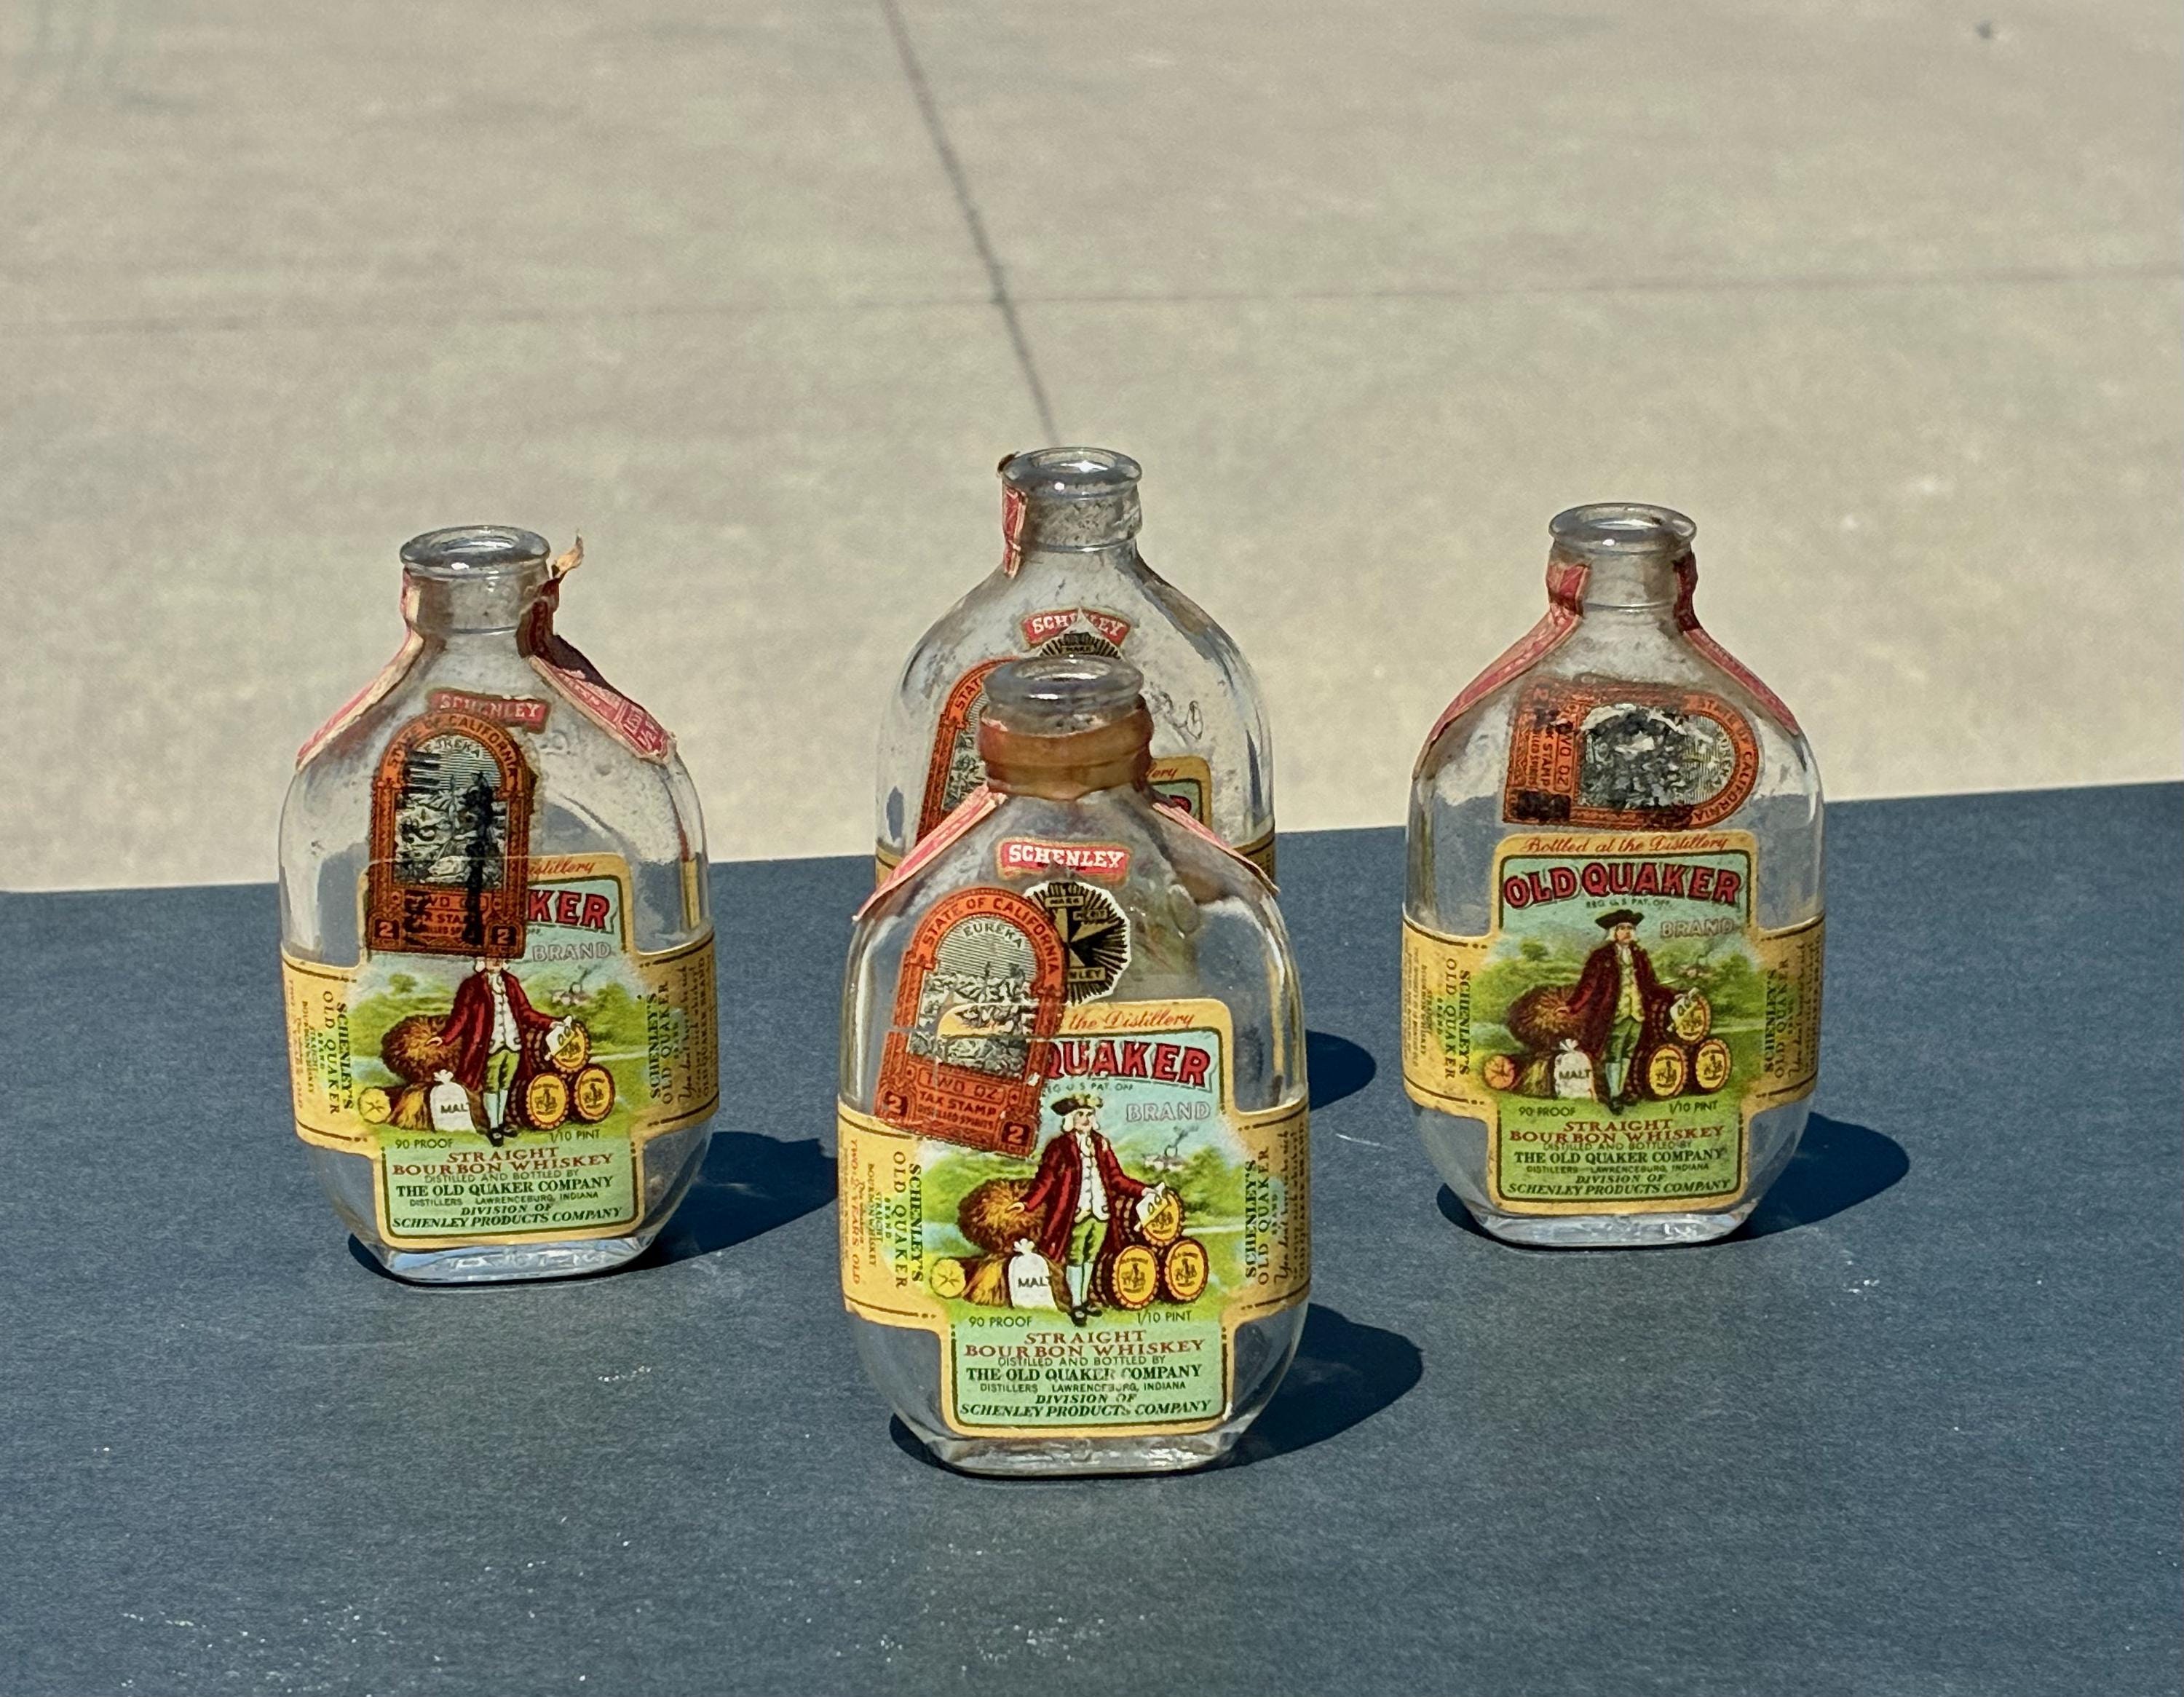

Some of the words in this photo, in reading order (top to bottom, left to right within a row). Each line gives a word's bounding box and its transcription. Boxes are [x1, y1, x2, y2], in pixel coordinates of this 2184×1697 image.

[955, 673, 985, 711] STAT
[1540, 743, 1553, 787] STAMP
[1519, 838, 1586, 853] Bottled
[1595, 838, 1615, 853] at
[1618, 836, 1643, 853] the
[1648, 834, 1728, 851] Distillery
[1009, 844, 1125, 868] SCHENLEY
[1504, 866, 1578, 909] OLD
[1581, 861, 1741, 906] QUAKER
[529, 888, 610, 930] KER
[379, 922, 393, 938] 2
[497, 928, 510, 944] 2
[924, 905, 961, 946] STATE
[967, 897, 986, 910] OF
[993, 898, 1060, 974] CALIFORNIA
[963, 922, 1024, 947] EUREKA
[1660, 918, 1734, 938] BRAND
[532, 941, 612, 962] BRAND
[1446, 958, 1457, 996] OLD
[1776, 959, 1789, 1034] QUAKER
[323, 990, 336, 1029] OLD
[1068, 1010, 1099, 1030] the
[1102, 1008, 1195, 1029] Distillery
[657, 981, 672, 1059] QUAKER
[1459, 970, 1471, 1075] SCHENLEY'S
[1764, 969, 1776, 1073] SCHENLEY'S
[646, 992, 660, 1099] SCHENLEY'S
[1444, 1005, 1457, 1080] QUAKER
[336, 1002, 355, 1110] SCHENLEY'S
[1774, 1041, 1785, 1079] OLD
[324, 1039, 340, 1115] QUAKER
[925, 1072, 965, 1093] TWO
[1559, 1069, 1592, 1080] MALT
[661, 1067, 673, 1104] OLD
[440, 1102, 471, 1114] MALT
[887, 1094, 903, 1114] 2
[919, 1091, 944, 1107] TAX
[949, 1098, 997, 1116] STAMP
[1126, 1101, 1211, 1123] BRAND
[1519, 1106, 1533, 1117] 90
[1537, 1107, 1576, 1117] PROOF
[1669, 1101, 1691, 1115] 1/10
[1694, 1100, 1718, 1112] PINT
[1009, 1126, 1024, 1144] 2
[1510, 1131, 1616, 1144] BOURBON
[1625, 1126, 1725, 1142] WHISKEY
[1563, 1119, 1674, 1133] STRAIGHT
[395, 1138, 411, 1150] 90
[414, 1137, 454, 1149] PROOF
[549, 1131, 571, 1144] 1/10
[576, 1129, 601, 1140] PINT
[446, 1147, 560, 1164] STRAIGHT
[1514, 1151, 1546, 1164] THE
[1549, 1151, 1580, 1163] OLD
[1585, 1151, 1647, 1165] QUAKER
[1652, 1147, 1722, 1164] COMPANY
[1543, 1142, 1593, 1152] DISTILLED
[1597, 1142, 1624, 1151] AND
[392, 1163, 502, 1176] BOURBON
[509, 1153, 614, 1172] WHISKEY
[893, 1151, 906, 1194] OLD
[1671, 1163, 1709, 1172] INDIANA
[424, 1174, 476, 1184] DISTILLED
[480, 1172, 508, 1182] AND
[513, 1170, 562, 1181] BOTTLED
[566, 1168, 579, 1178] BY
[1575, 1174, 1642, 1184] DIVISION
[1647, 1174, 1666, 1183] OF
[396, 1184, 429, 1198] THE
[432, 1183, 464, 1196] OLD
[469, 1182, 534, 1196] QUAKER
[538, 1176, 614, 1192] COMPANY
[1257, 1147, 1270, 1233] QUAKER
[1508, 1184, 1581, 1196] SCHENLEY
[1585, 1183, 1661, 1195] PRODUCTS
[1664, 1179, 1732, 1194] COMPANY
[410, 1198, 464, 1207] DISTILLERS
[560, 1191, 599, 1201] INDIANA
[392, 1217, 468, 1229] SCHENLEY
[472, 1213, 550, 1227] PRODUCTS
[552, 1207, 623, 1222] COMPANY
[461, 1205, 528, 1216] DIVISION
[534, 1203, 553, 1213] OF
[1245, 1160, 1257, 1279] SCHENLEY'S
[909, 1163, 925, 1283] SCHENLEY'S
[892, 1204, 909, 1289] QUAKER
[1258, 1243, 1269, 1286] OLD
[1018, 1275, 1050, 1288] MALT
[968, 1316, 985, 1328] 90
[989, 1316, 1033, 1328] PROOF
[1137, 1312, 1161, 1326] 1/10
[1166, 1310, 1192, 1322] PINT
[1024, 1330, 1147, 1345] STRAIGHT
[964, 1345, 1084, 1358] BOURBON
[1092, 1339, 1206, 1358] WHISKEY
[998, 1356, 1053, 1367] DISTILLED
[1059, 1357, 1088, 1366] AND
[1093, 1355, 1147, 1366] BOTTLED
[1152, 1355, 1166, 1365] BY
[965, 1367, 1002, 1382] THE
[1005, 1367, 1040, 1381] OLD
[1045, 1367, 1115, 1382] QUAKER
[1120, 1364, 1203, 1381] COMPANY
[980, 1383, 1039, 1393] DISTILLERS
[1144, 1381, 1186, 1391] INDIANA
[960, 1403, 1045, 1417] SCHENLEY
[1046, 1404, 1130, 1417] PRODUCTS
[1134, 1399, 1212, 1416] COMPANY
[1035, 1393, 1108, 1404] DIVISION
[1116, 1393, 1138, 1404] OF
